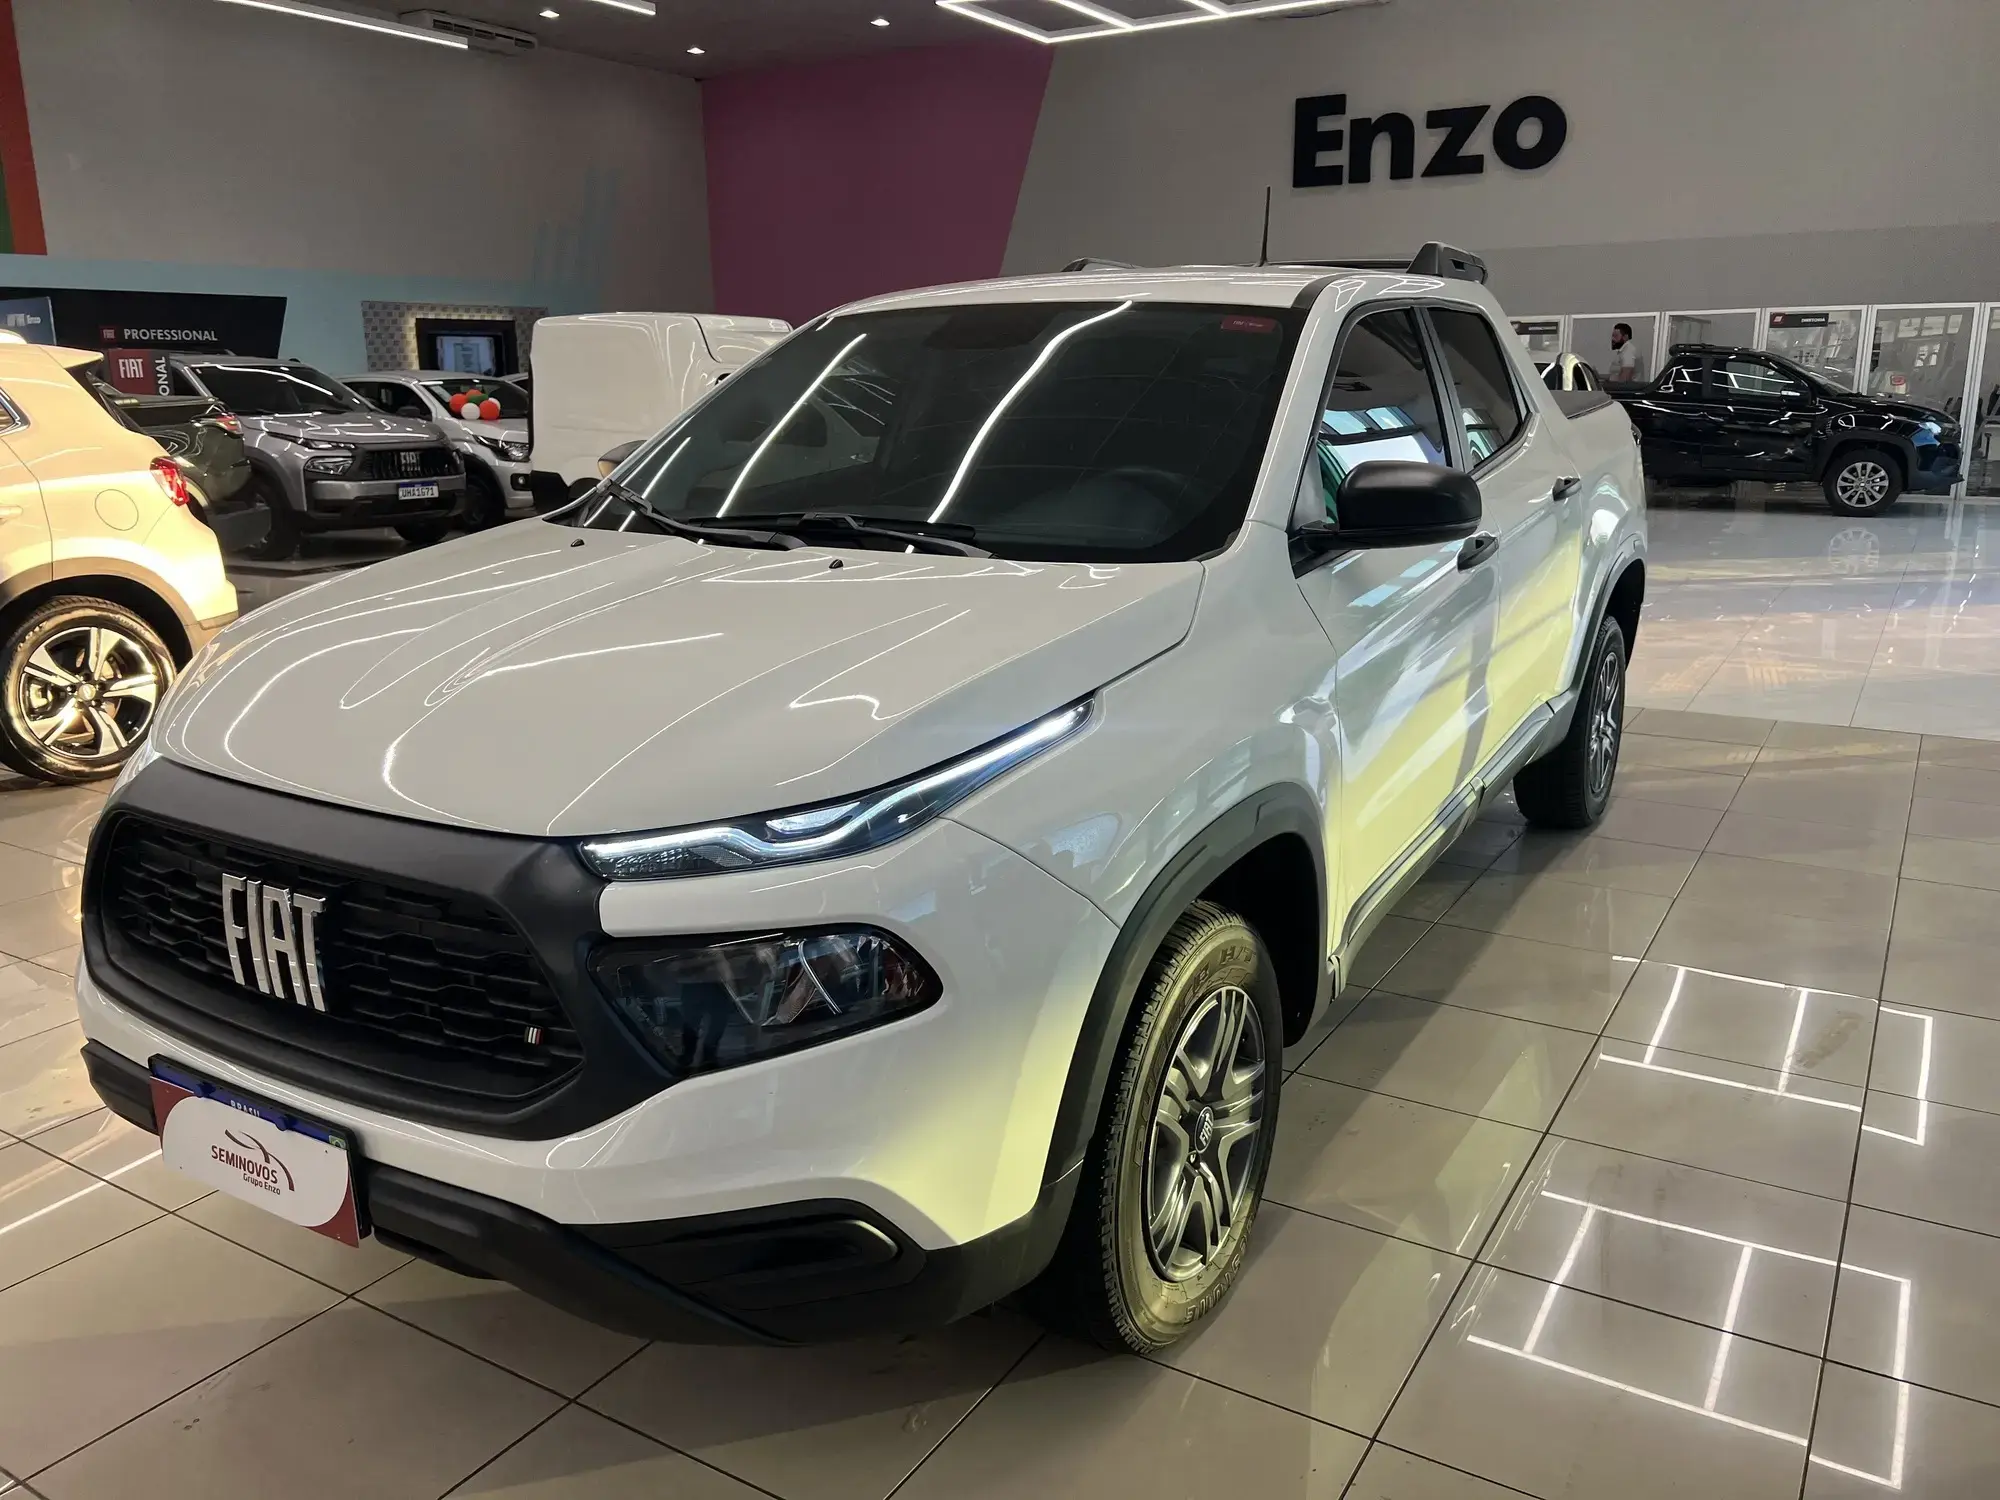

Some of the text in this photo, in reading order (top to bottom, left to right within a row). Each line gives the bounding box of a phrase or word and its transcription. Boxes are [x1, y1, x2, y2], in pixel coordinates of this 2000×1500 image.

[1292, 94, 1567, 188] Enzo
[123, 328, 219, 341] PROFESSIONAL
[118, 358, 144, 379] FIAT
[222, 872, 326, 1012] FIAT
[1199, 1112, 1214, 1147] FIAT
[211, 1144, 279, 1185] SEMINOVOS
[243, 1172, 281, 1196] Grupo Enzo
